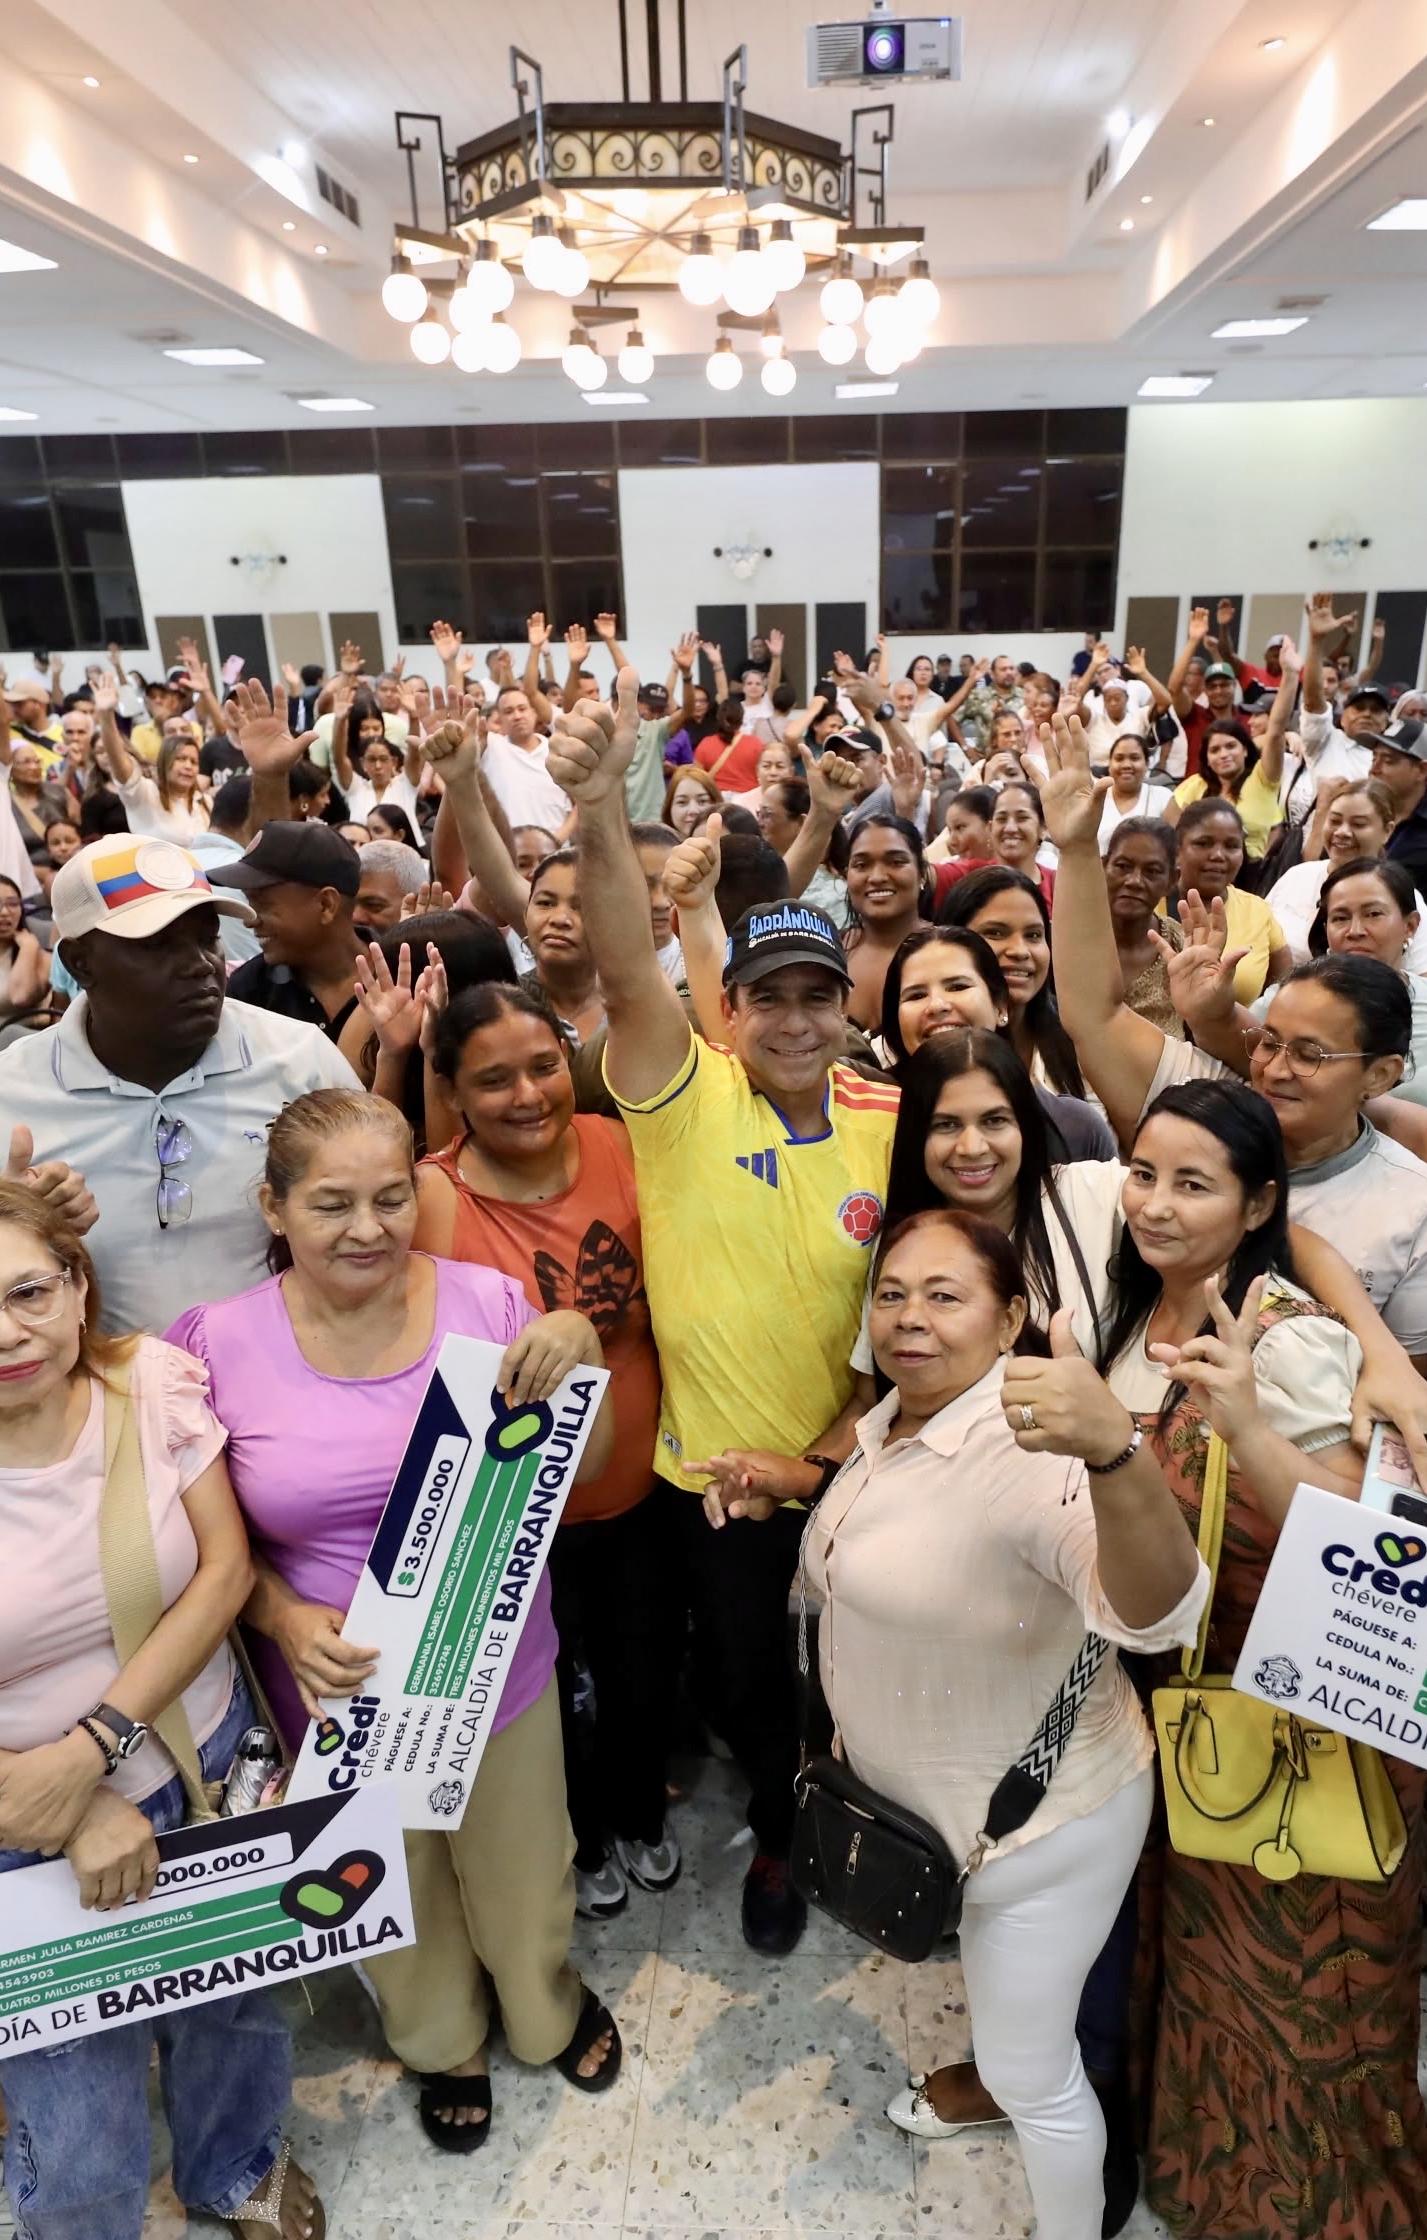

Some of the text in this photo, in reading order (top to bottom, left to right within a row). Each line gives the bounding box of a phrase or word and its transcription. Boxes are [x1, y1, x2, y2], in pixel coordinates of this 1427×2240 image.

[448, 1380, 598, 1773] ALCALDÍA DE BARRANQUILLA
[1331, 1580, 1417, 1623] chévere
[409, 1524, 473, 1693] GERMANIA ISABEL OSORIO SANCHEZ
[450, 1519, 515, 1697] TRES MILLONES QUINIENTOS MIL PESOS
[1332, 1608, 1418, 1650] PÁGUESE A:
[429, 1645, 452, 1695] 32692748
[1315, 1656, 1333, 1671] LA
[1337, 1665, 1381, 1691] SUMA
[1385, 1684, 1409, 1702] DE:
[1325, 1631, 1415, 1675] CEDULA No.:
[328, 1695, 381, 1791] Credi
[360, 1712, 391, 1778] chévere
[384, 1706, 413, 1771] PÁGUESE A:
[404, 1729, 425, 1772] CEDULA
[425, 1703, 456, 1774] LA SUMA DE:
[0, 1911, 194, 1969] RMEN JULIA RAMIREZ CARDENAS
[44, 1977, 103, 2000] MILLONES
[105, 1972, 121, 1984] DE
[123, 1961, 162, 1978] PESOS
[51, 2003, 88, 2030] DE
[97, 1915, 403, 2020] BARRANQUILLA
